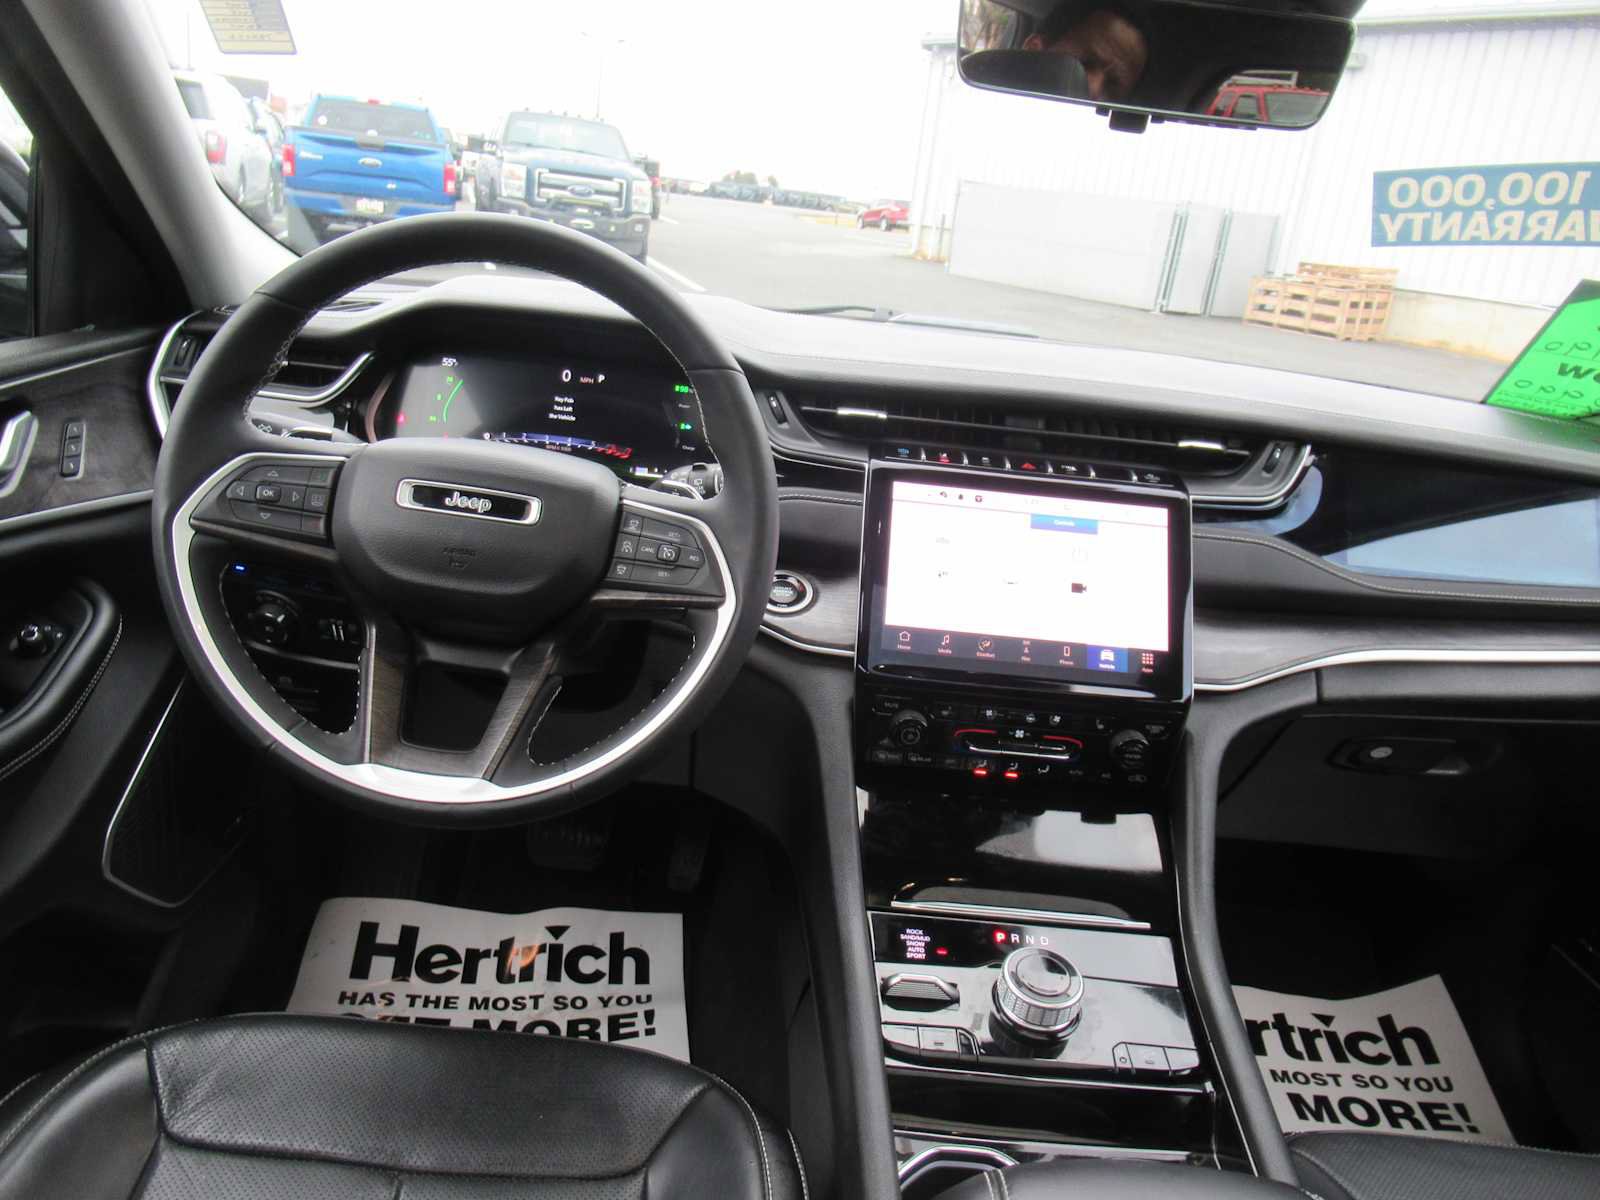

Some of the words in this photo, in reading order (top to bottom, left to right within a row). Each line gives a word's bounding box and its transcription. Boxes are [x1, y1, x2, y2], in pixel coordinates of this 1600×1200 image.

[562, 369, 572, 382] 0
[262, 489, 274, 497] OK
[445, 491, 493, 513] Jeep
[995, 931, 1005, 942] P
[1010, 933, 1020, 943] R
[1025, 935, 1034, 944] N
[1040, 936, 1049, 945] D
[348, 920, 651, 985] Hertrich
[906, 952, 927, 960] SPORT
[338, 990, 395, 1007] HAS
[405, 993, 460, 1011] THE
[468, 994, 545, 1012] MOST
[552, 995, 588, 1011] SO
[598, 993, 653, 1009] YOU
[1244, 1012, 1441, 1067] rtrich
[1269, 1069, 1343, 1088] MOST
[1352, 1073, 1389, 1090] SO
[1394, 1075, 1454, 1093] YOU
[1286, 1092, 1481, 1134] MORE!
